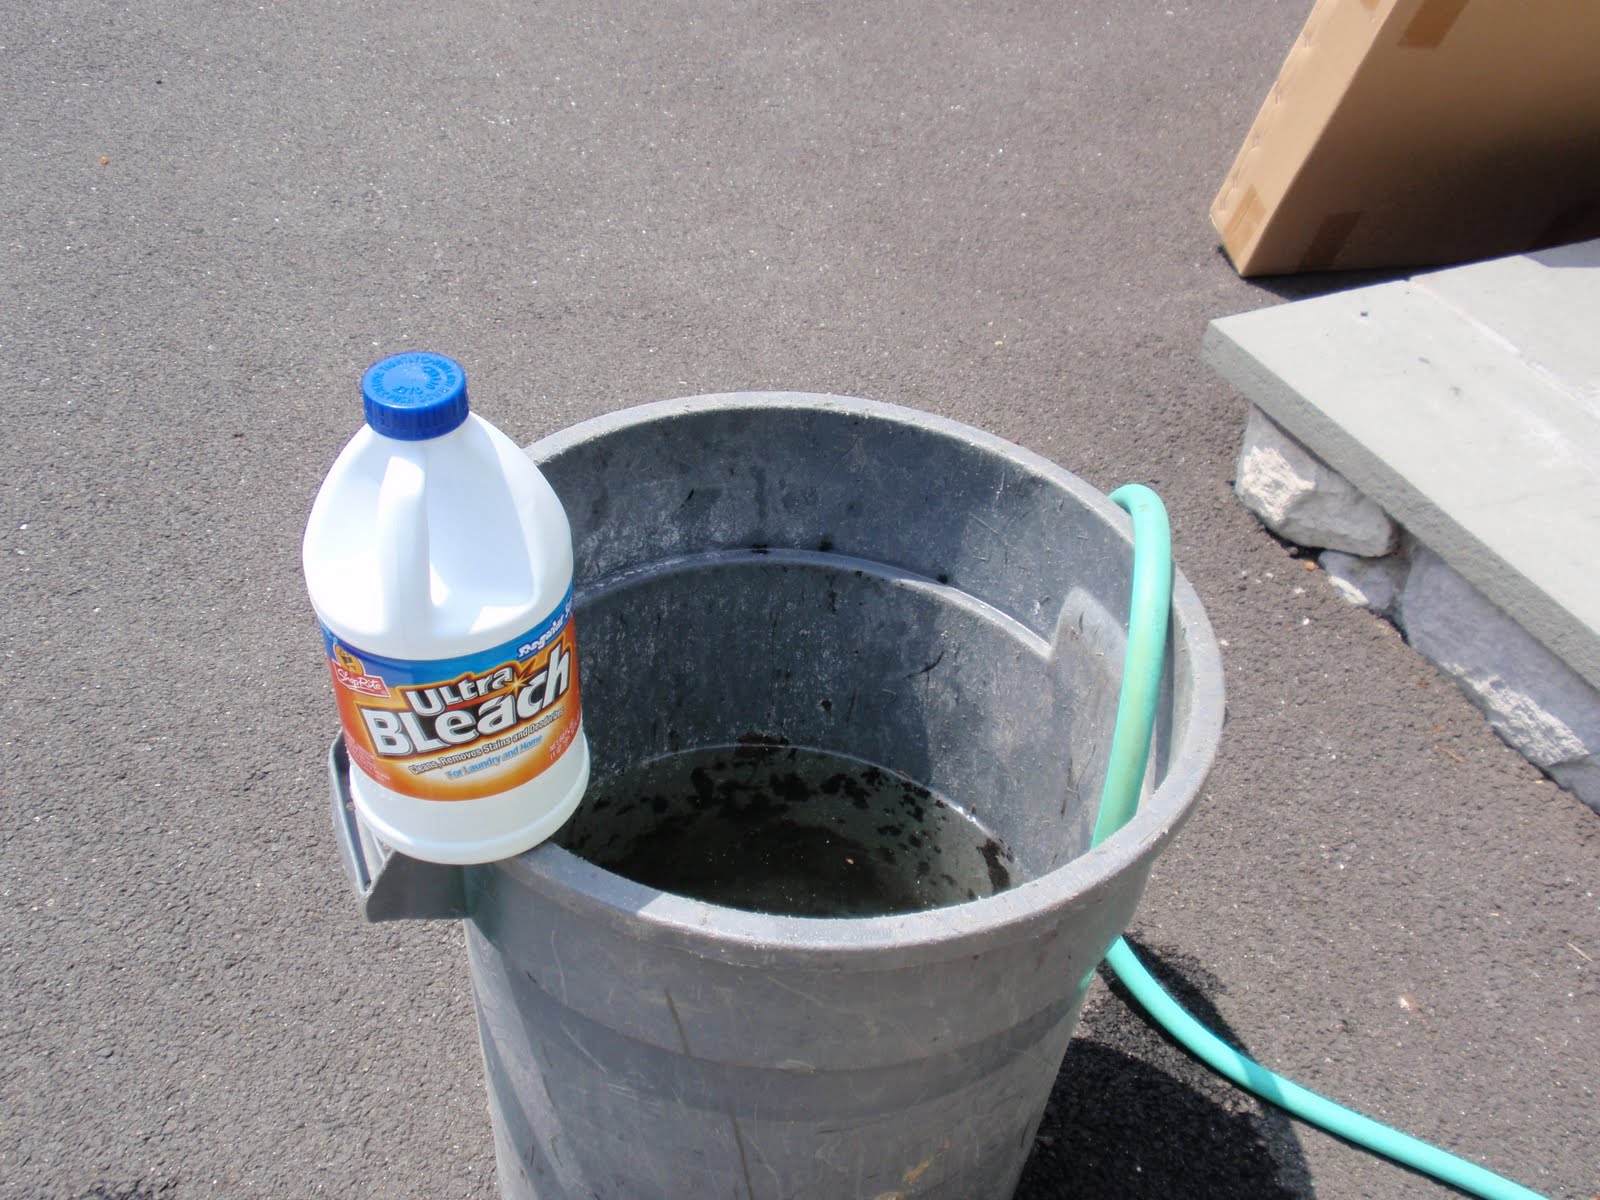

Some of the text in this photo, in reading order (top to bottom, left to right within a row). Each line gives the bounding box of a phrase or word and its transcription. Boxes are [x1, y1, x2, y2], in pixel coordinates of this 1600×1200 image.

[440, 747, 482, 768] Removes
[481, 736, 512, 755] Stains
[512, 728, 529, 743] and
[445, 735, 543, 780] For Laundry and Home
